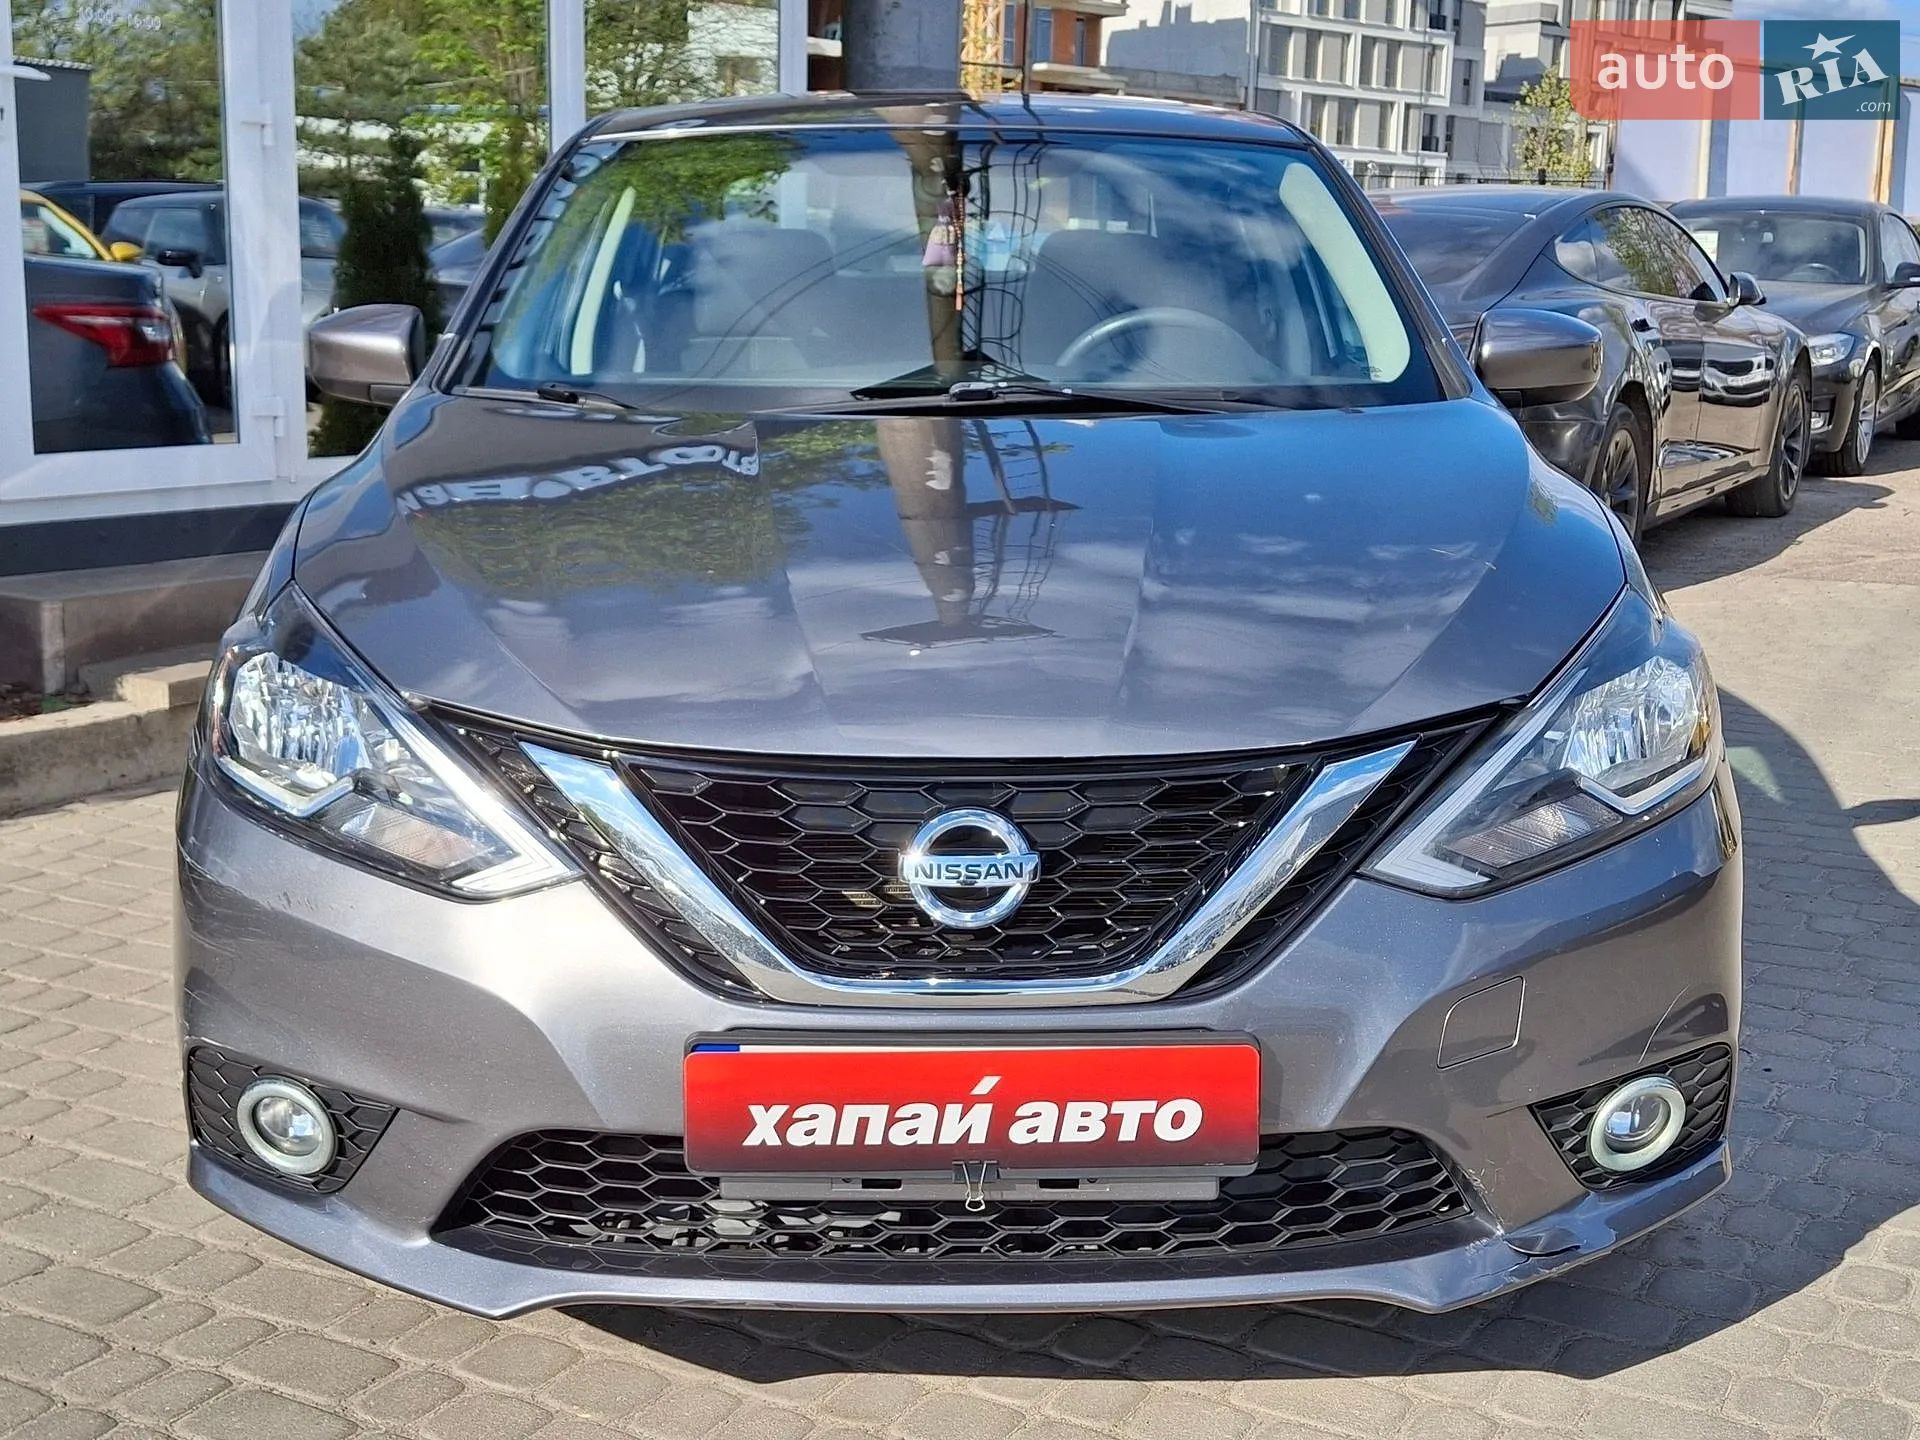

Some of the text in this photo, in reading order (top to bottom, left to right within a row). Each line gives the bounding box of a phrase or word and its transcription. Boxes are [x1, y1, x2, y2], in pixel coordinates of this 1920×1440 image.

[914, 862, 1024, 880] NISSAN
[742, 1076, 1203, 1147] хапай авто
